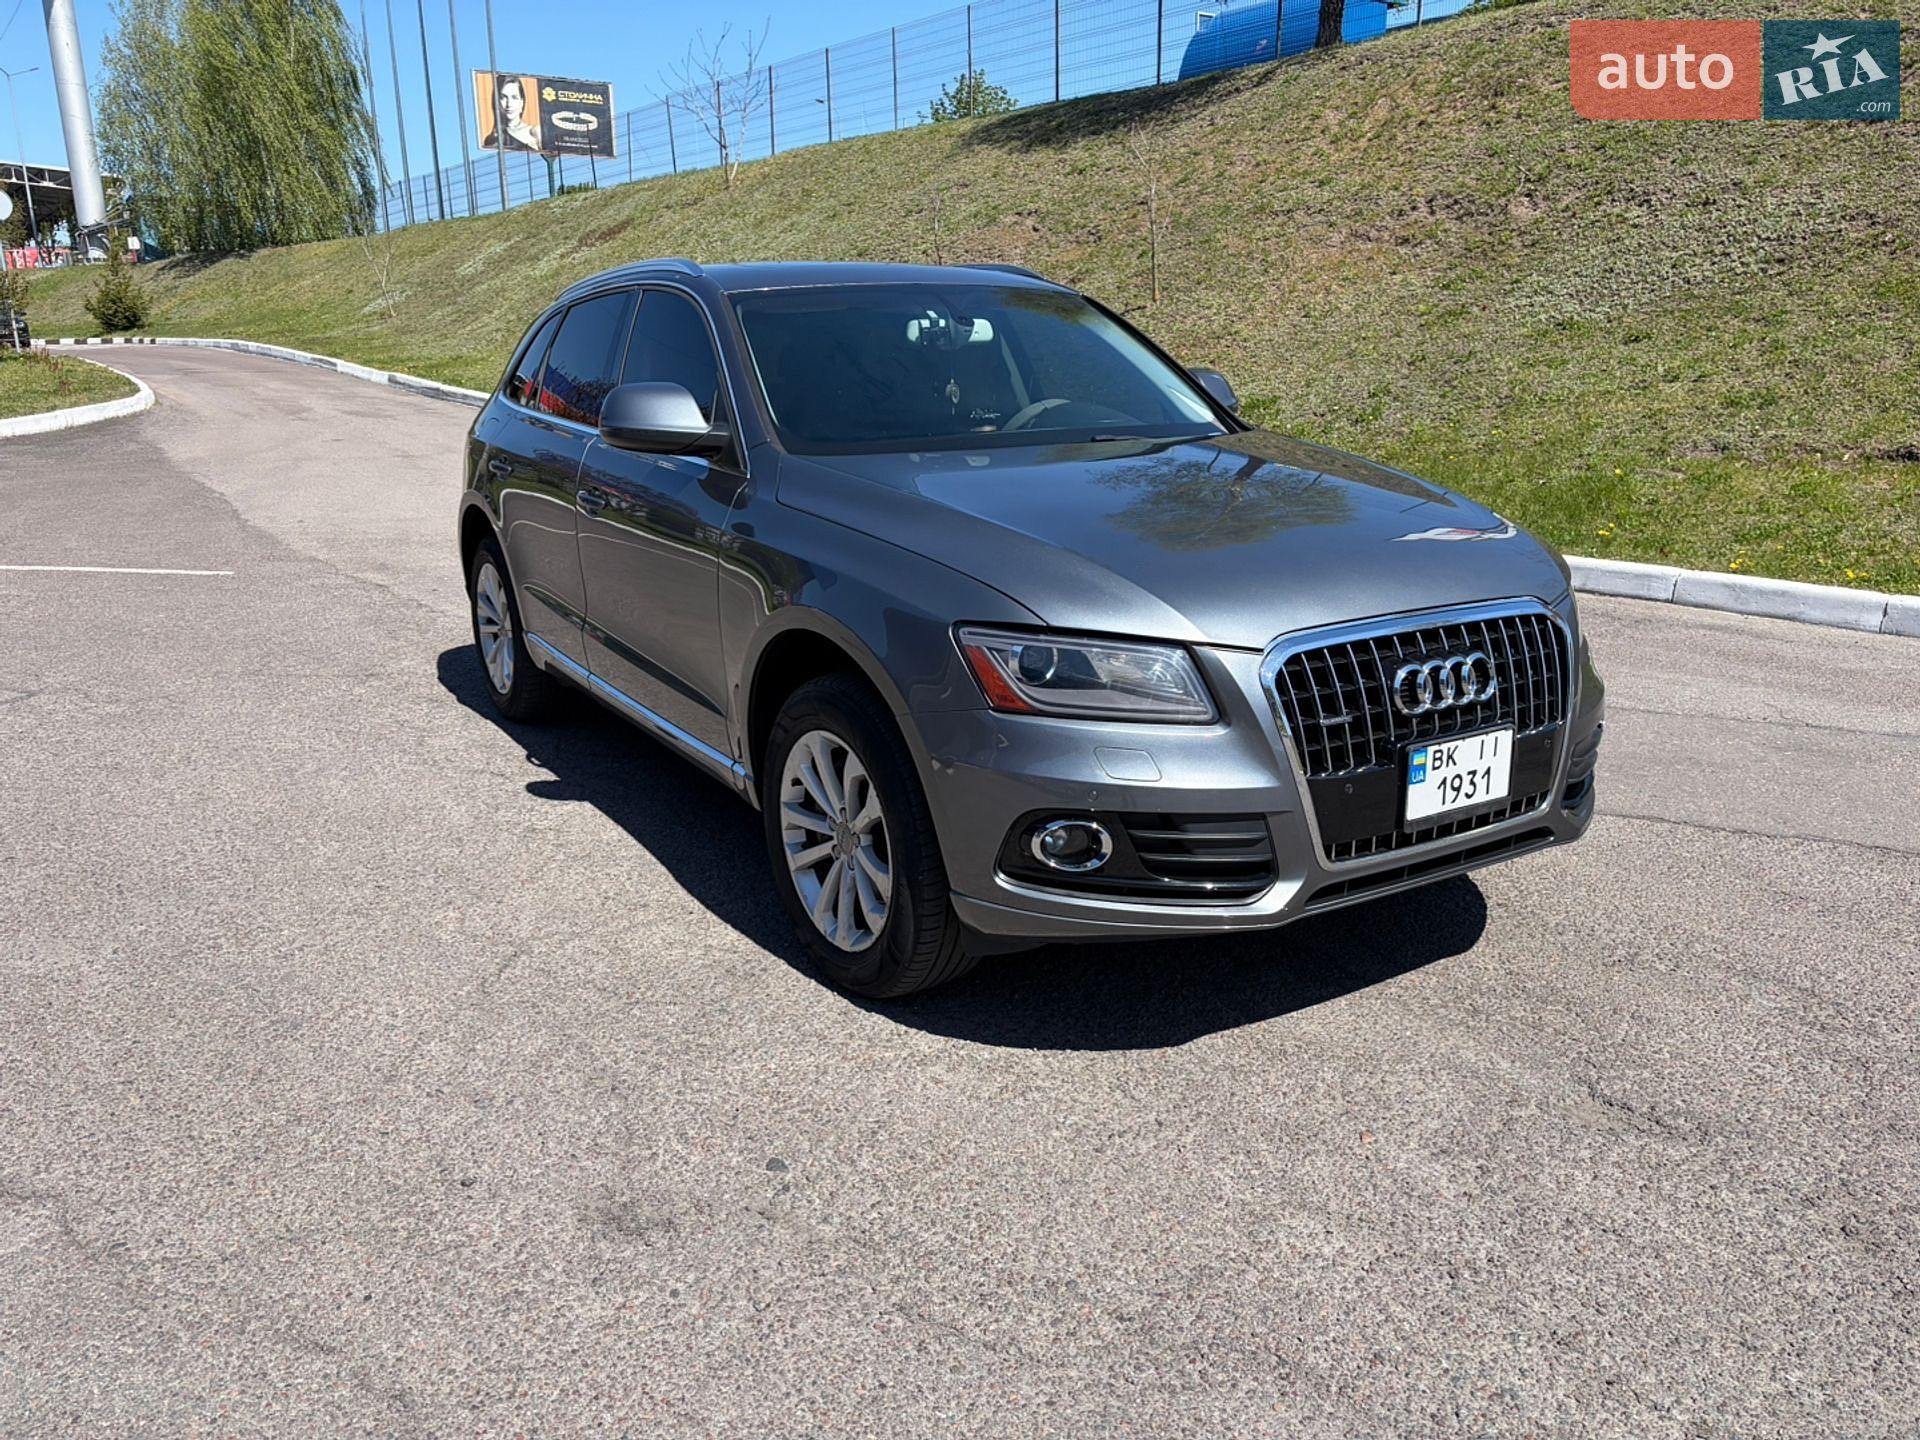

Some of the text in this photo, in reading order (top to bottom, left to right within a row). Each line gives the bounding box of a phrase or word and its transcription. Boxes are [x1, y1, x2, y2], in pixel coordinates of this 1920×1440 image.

[1431, 745, 1459, 771] BK
[1411, 770, 1424, 783] UA
[1436, 766, 1491, 806] 1931
